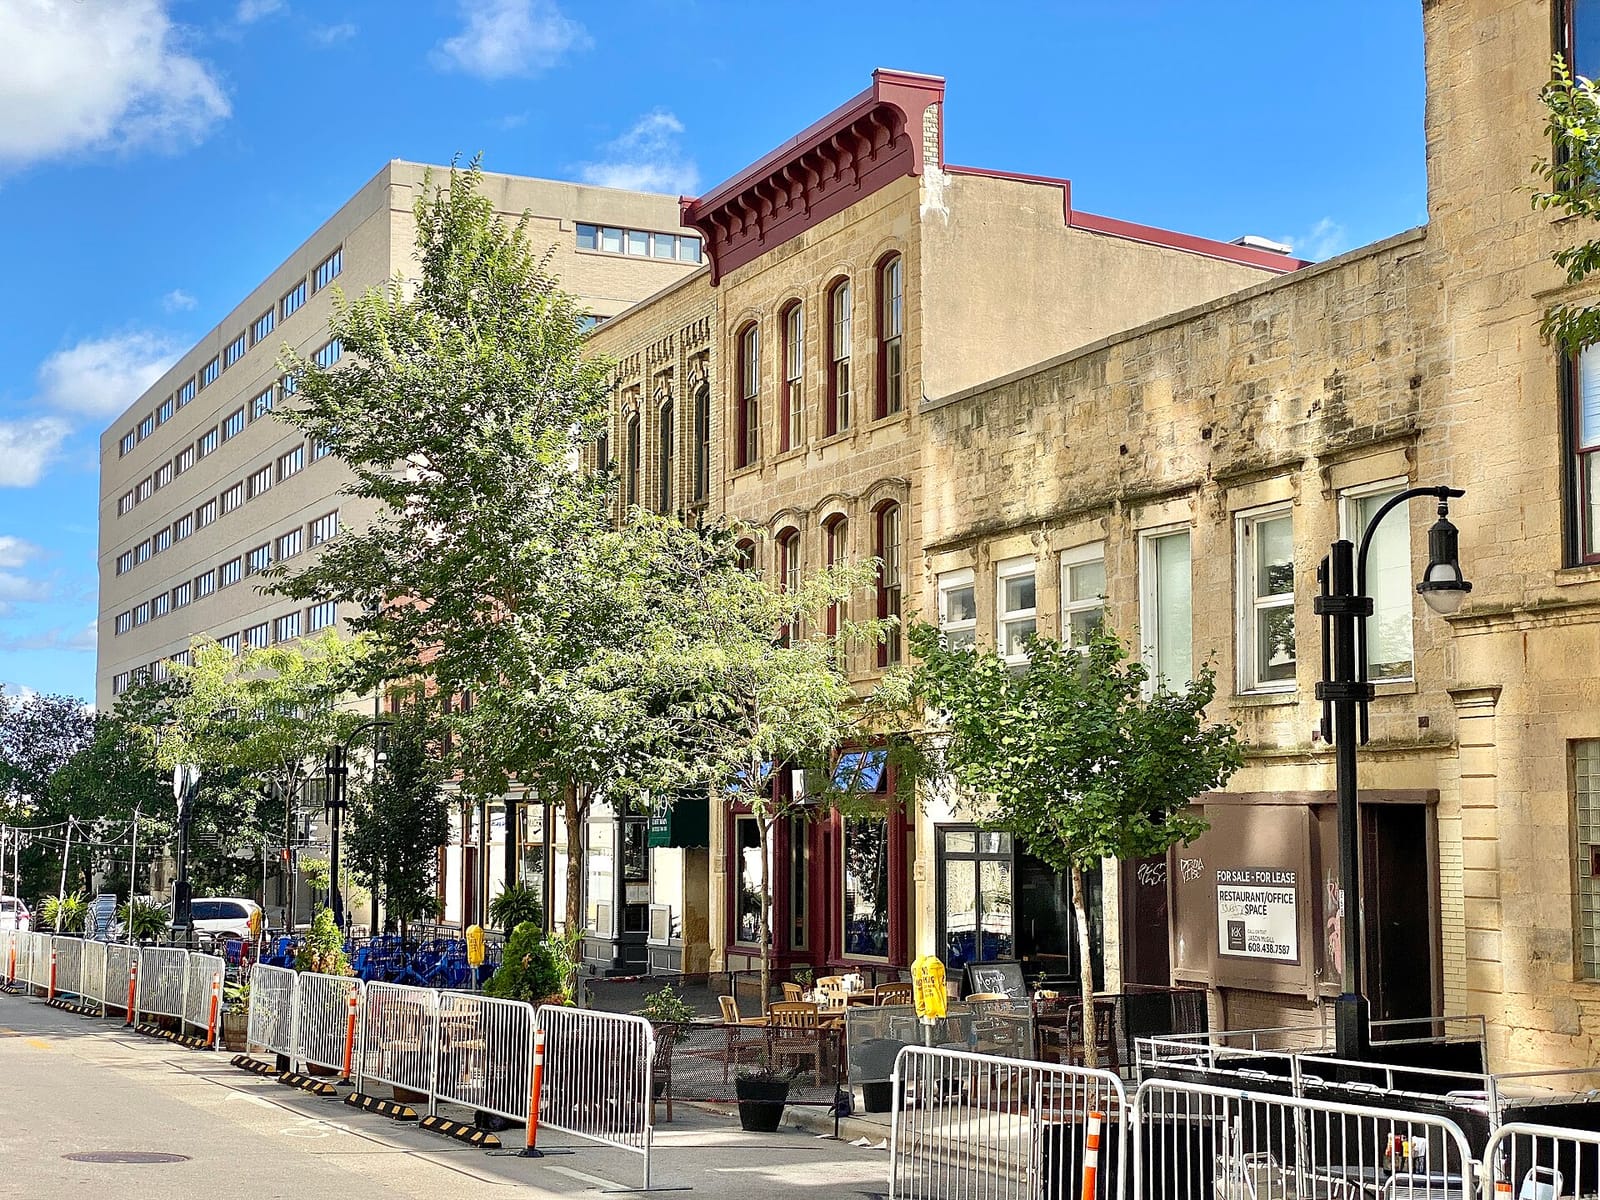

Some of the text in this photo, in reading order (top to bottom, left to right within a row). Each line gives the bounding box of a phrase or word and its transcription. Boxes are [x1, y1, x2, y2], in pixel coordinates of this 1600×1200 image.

[1216, 870, 1231, 882] FOR
[1232, 871, 1250, 882] SALE
[1255, 871, 1271, 883] FOR
[1272, 872, 1296, 884] LEASE
[1219, 890, 1294, 904] RESTAURANT/OFFICE
[1244, 904, 1267, 915] SPACE
[1248, 942, 1290, 954] 608.438.7587
